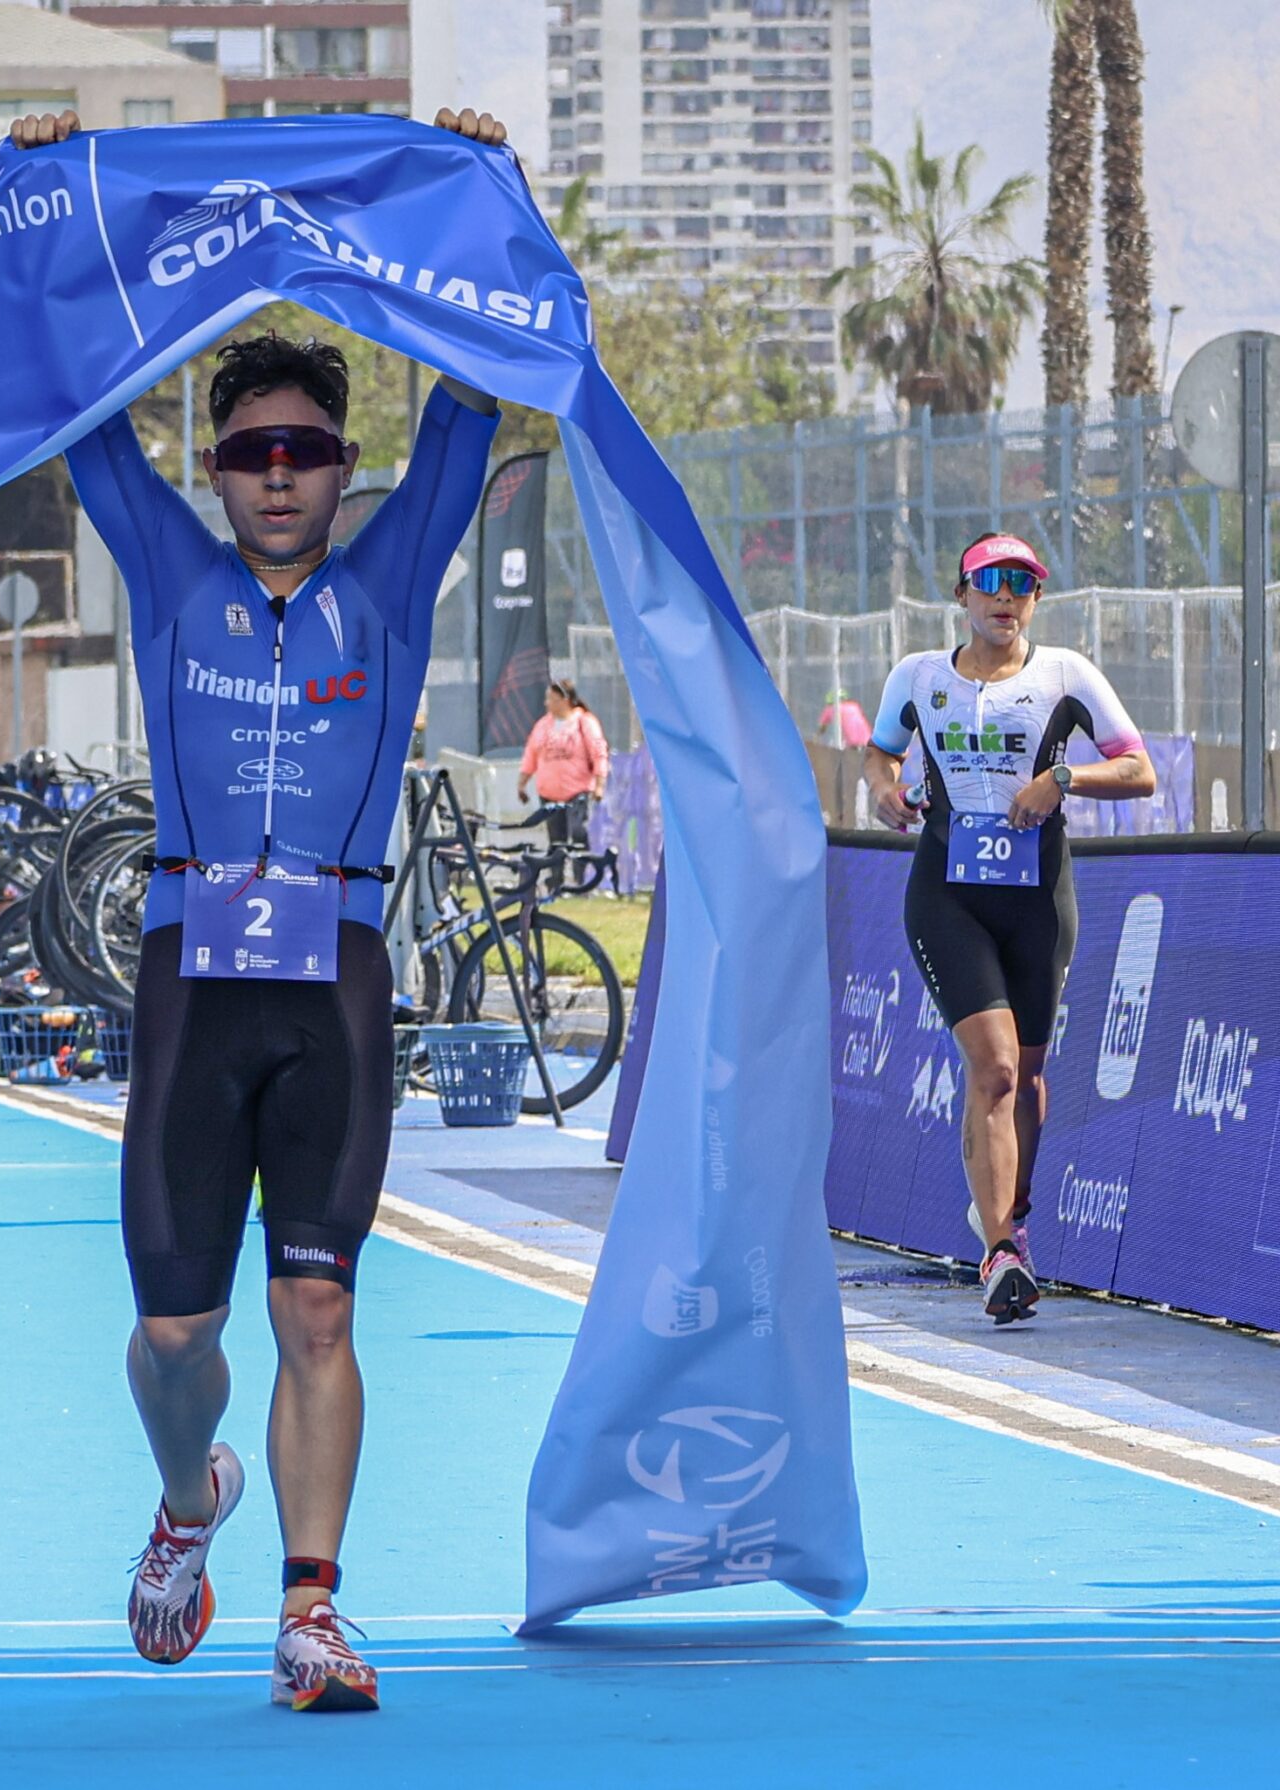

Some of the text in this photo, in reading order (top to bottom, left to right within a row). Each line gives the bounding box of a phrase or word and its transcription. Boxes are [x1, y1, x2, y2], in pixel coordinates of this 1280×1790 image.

[186, 657, 368, 705] Triatlón UC
[231, 728, 307, 746] cmpc
[935, 725, 1026, 754] IKIKE
[227, 782, 312, 798] SUBARU
[275, 839, 324, 860] GARMIN
[976, 836, 1012, 860] 20
[244, 898, 273, 937] 2
[842, 1031, 870, 1076] Chile
[1058, 1164, 1129, 1238] Corporate
[283, 1245, 336, 1264] Triatlón
